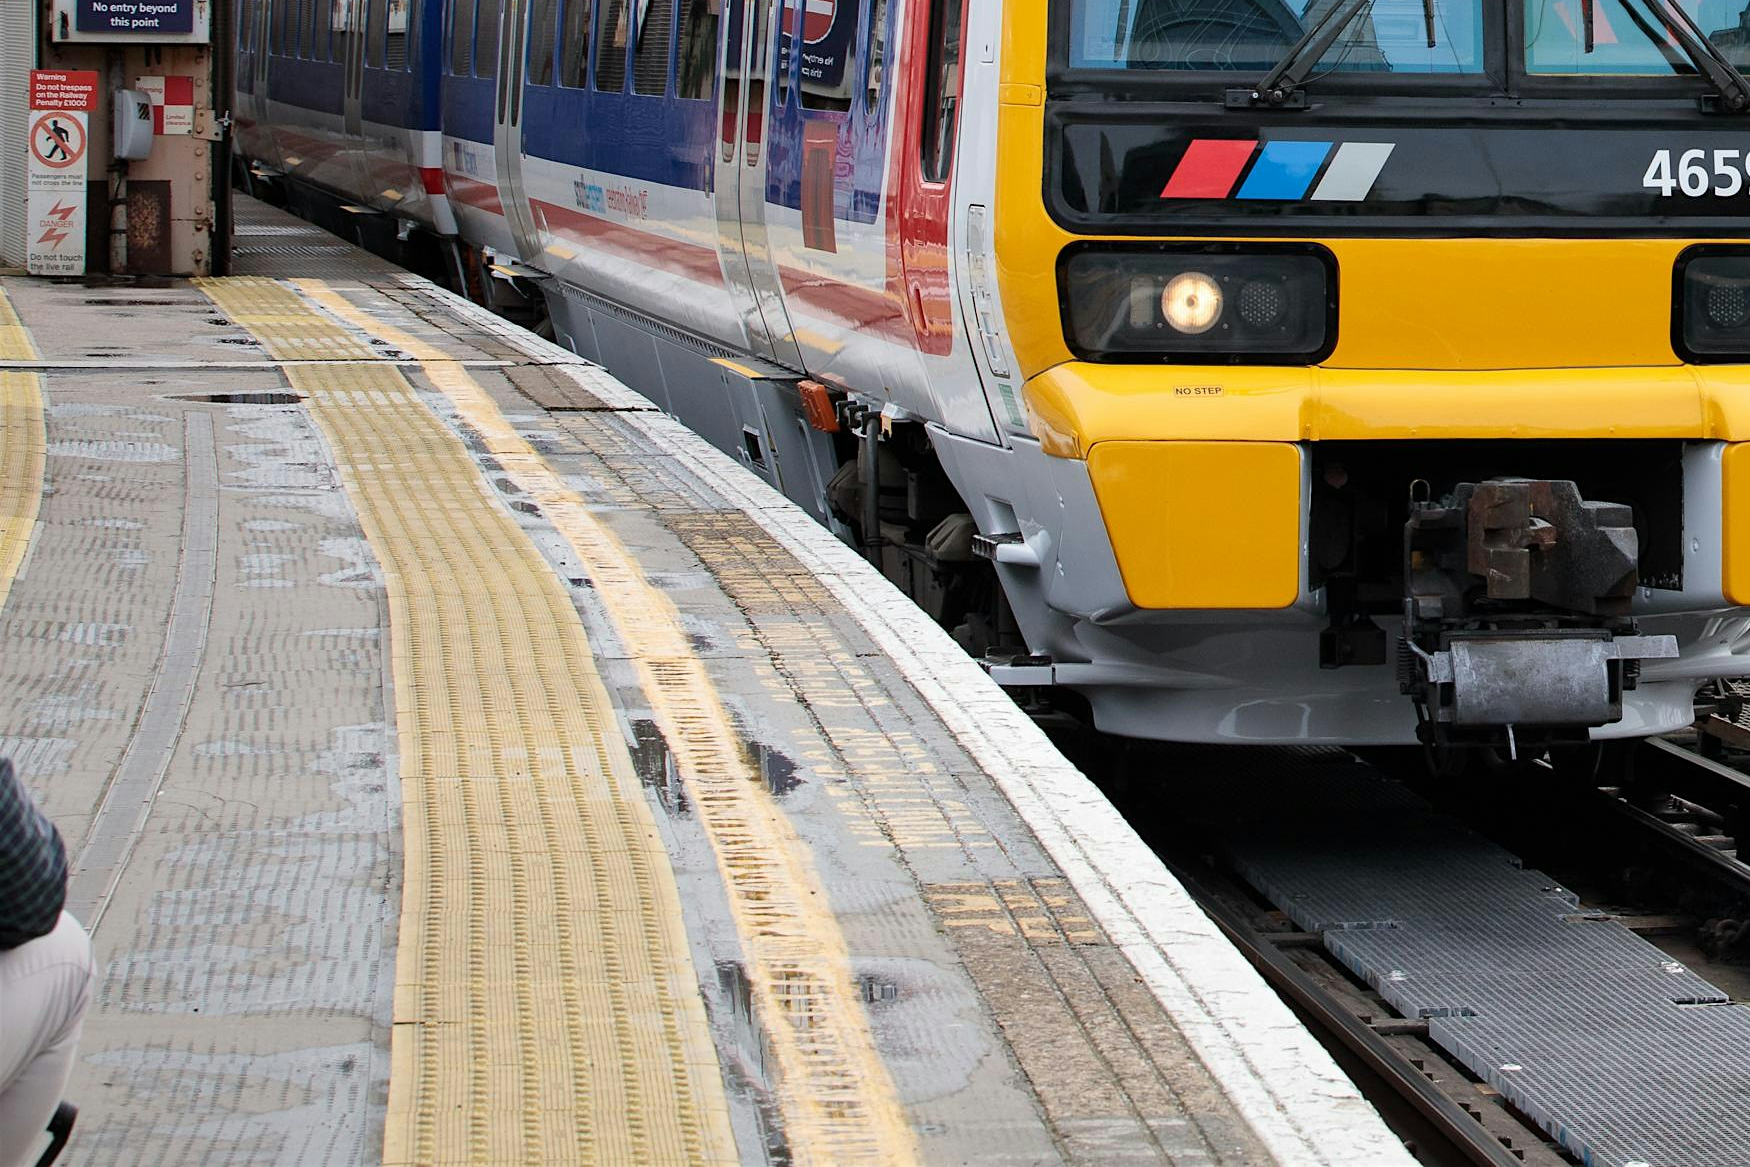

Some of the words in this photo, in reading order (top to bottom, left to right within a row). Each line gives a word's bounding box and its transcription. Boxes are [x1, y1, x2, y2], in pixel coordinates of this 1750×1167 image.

[92, 2, 108, 12] No
[109, 3, 137, 14] entry
[139, 3, 177, 14] beyond
[110, 17, 130, 27] this
[131, 18, 160, 28] point
[36, 73, 67, 82] Warning
[60, 84, 93, 92] trespass
[60, 92, 88, 100] Railway
[36, 99, 63, 107] Penalty
[63, 99, 88, 107] £1000
[39, 220, 74, 228] DANGER
[30, 253, 42, 261] Do
[59, 254, 84, 262] touch
[1175, 387, 1191, 395] NO
[1194, 387, 1222, 395] STEP
